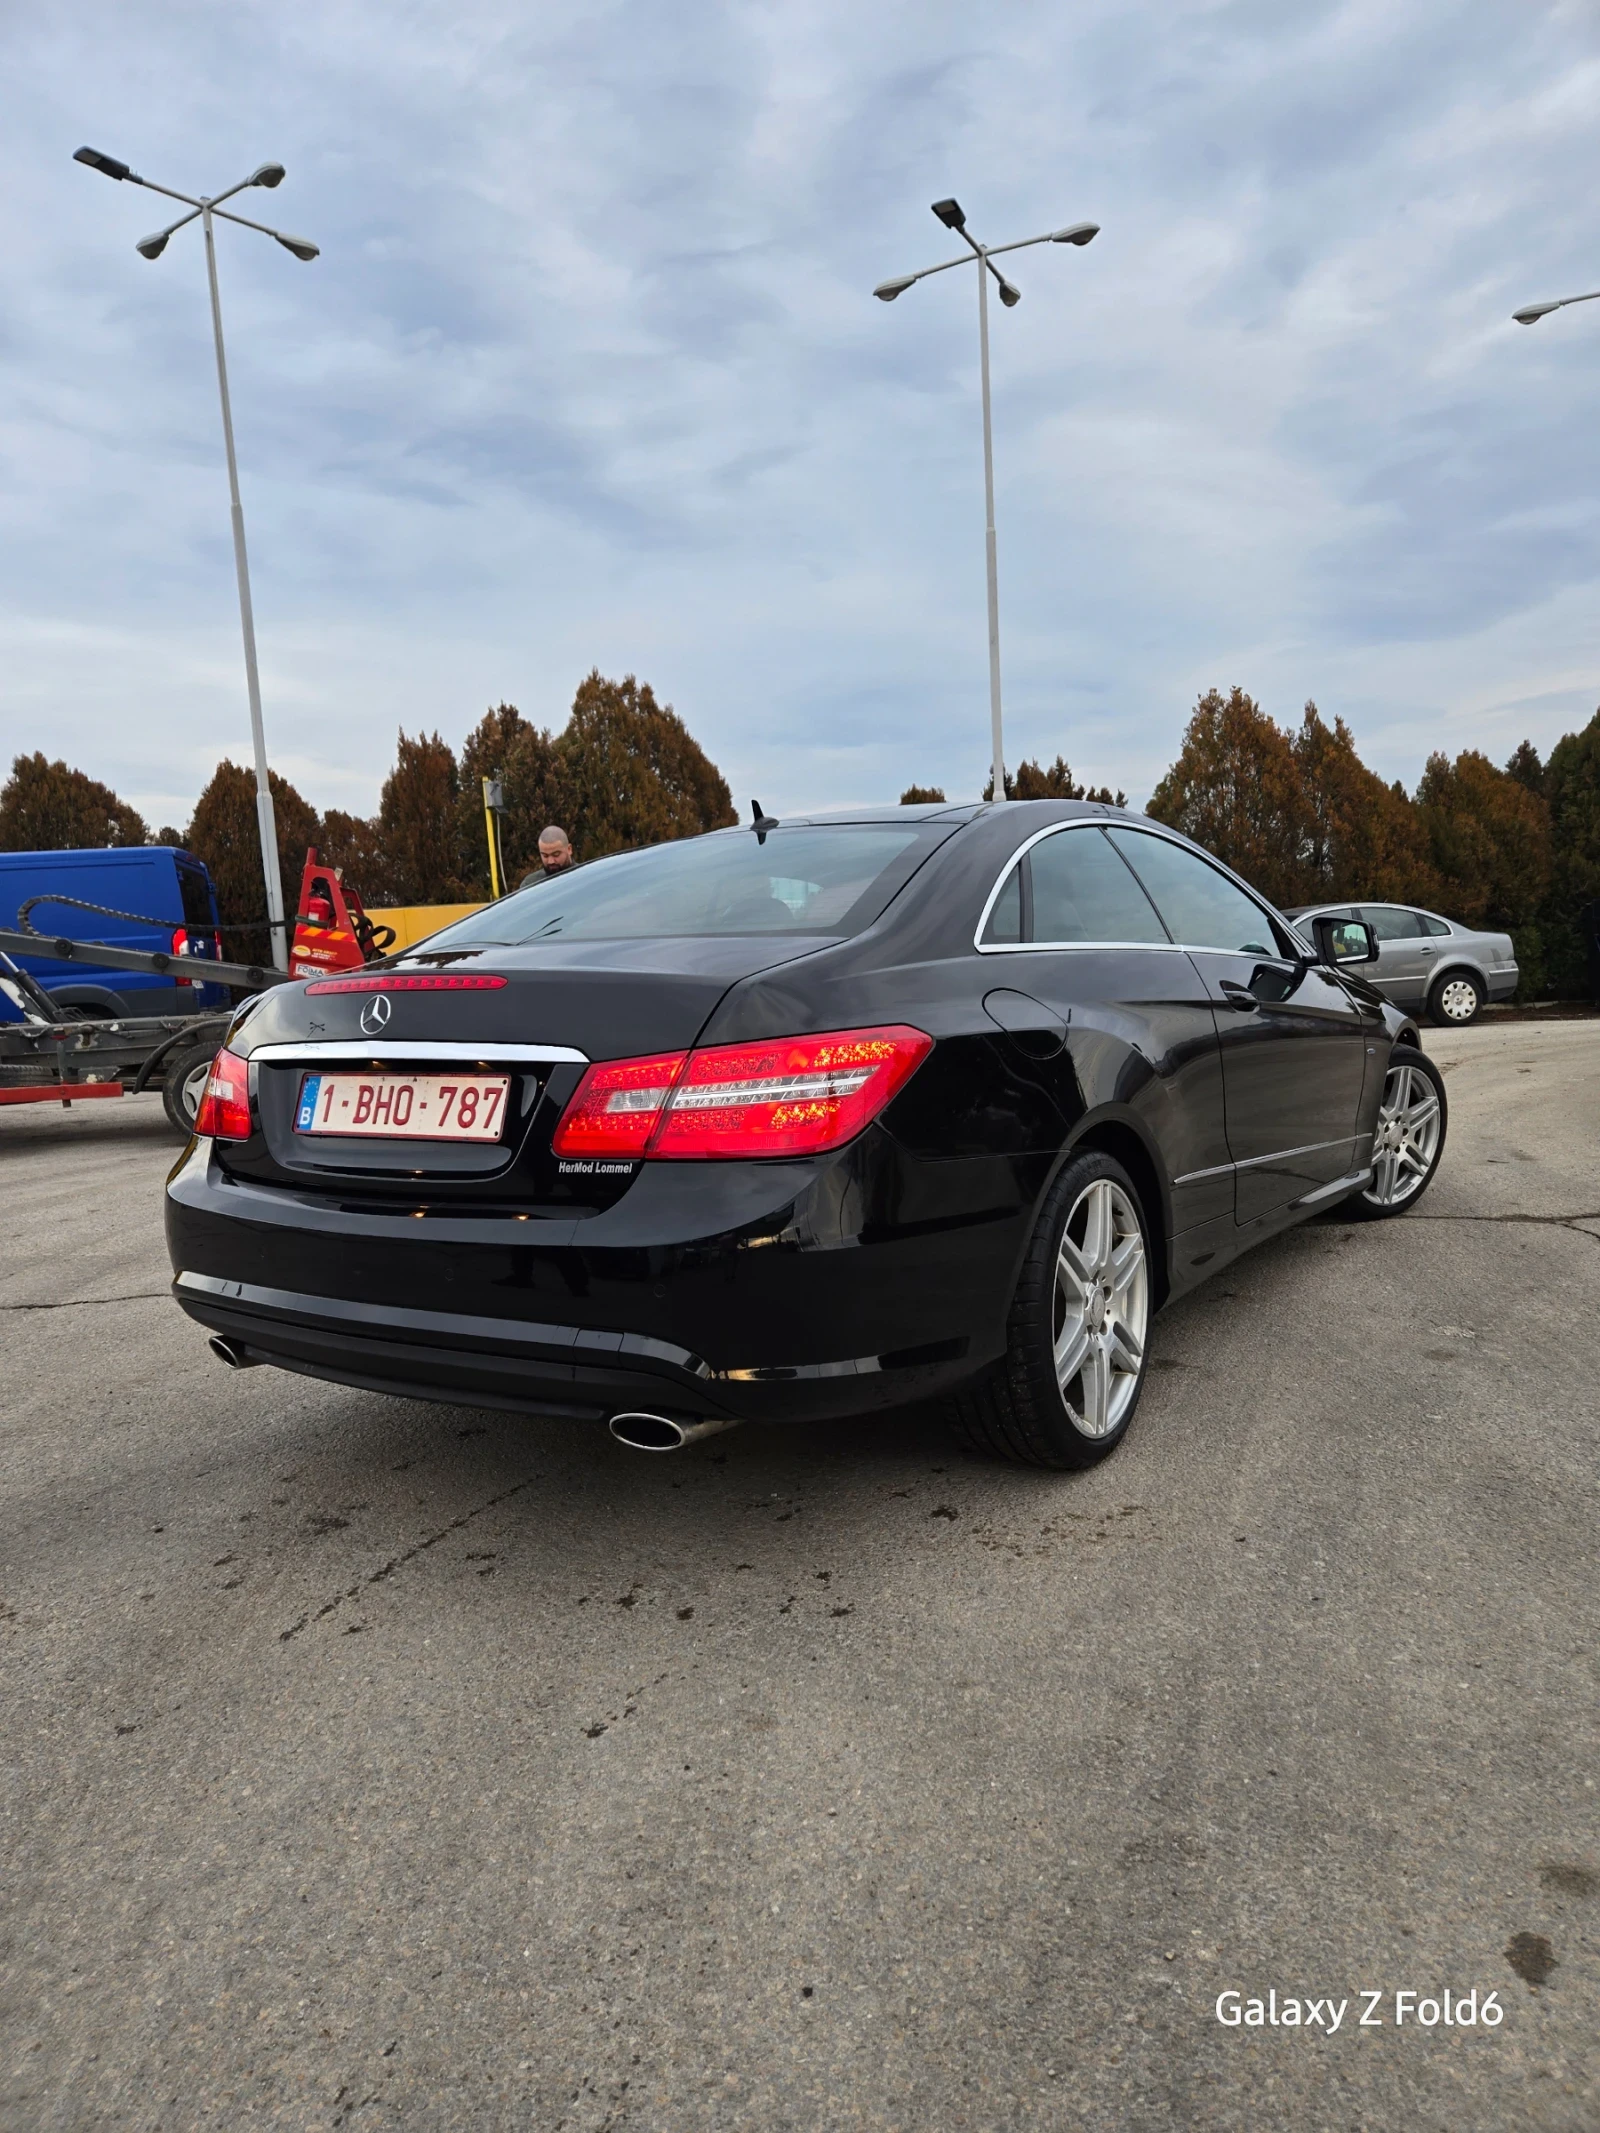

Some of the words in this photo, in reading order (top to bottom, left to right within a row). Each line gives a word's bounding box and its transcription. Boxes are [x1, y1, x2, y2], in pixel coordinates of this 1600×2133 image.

[299, 1107, 311, 1125] B
[558, 1161, 594, 1173] HerMod
[595, 1161, 633, 1174] Lommel
